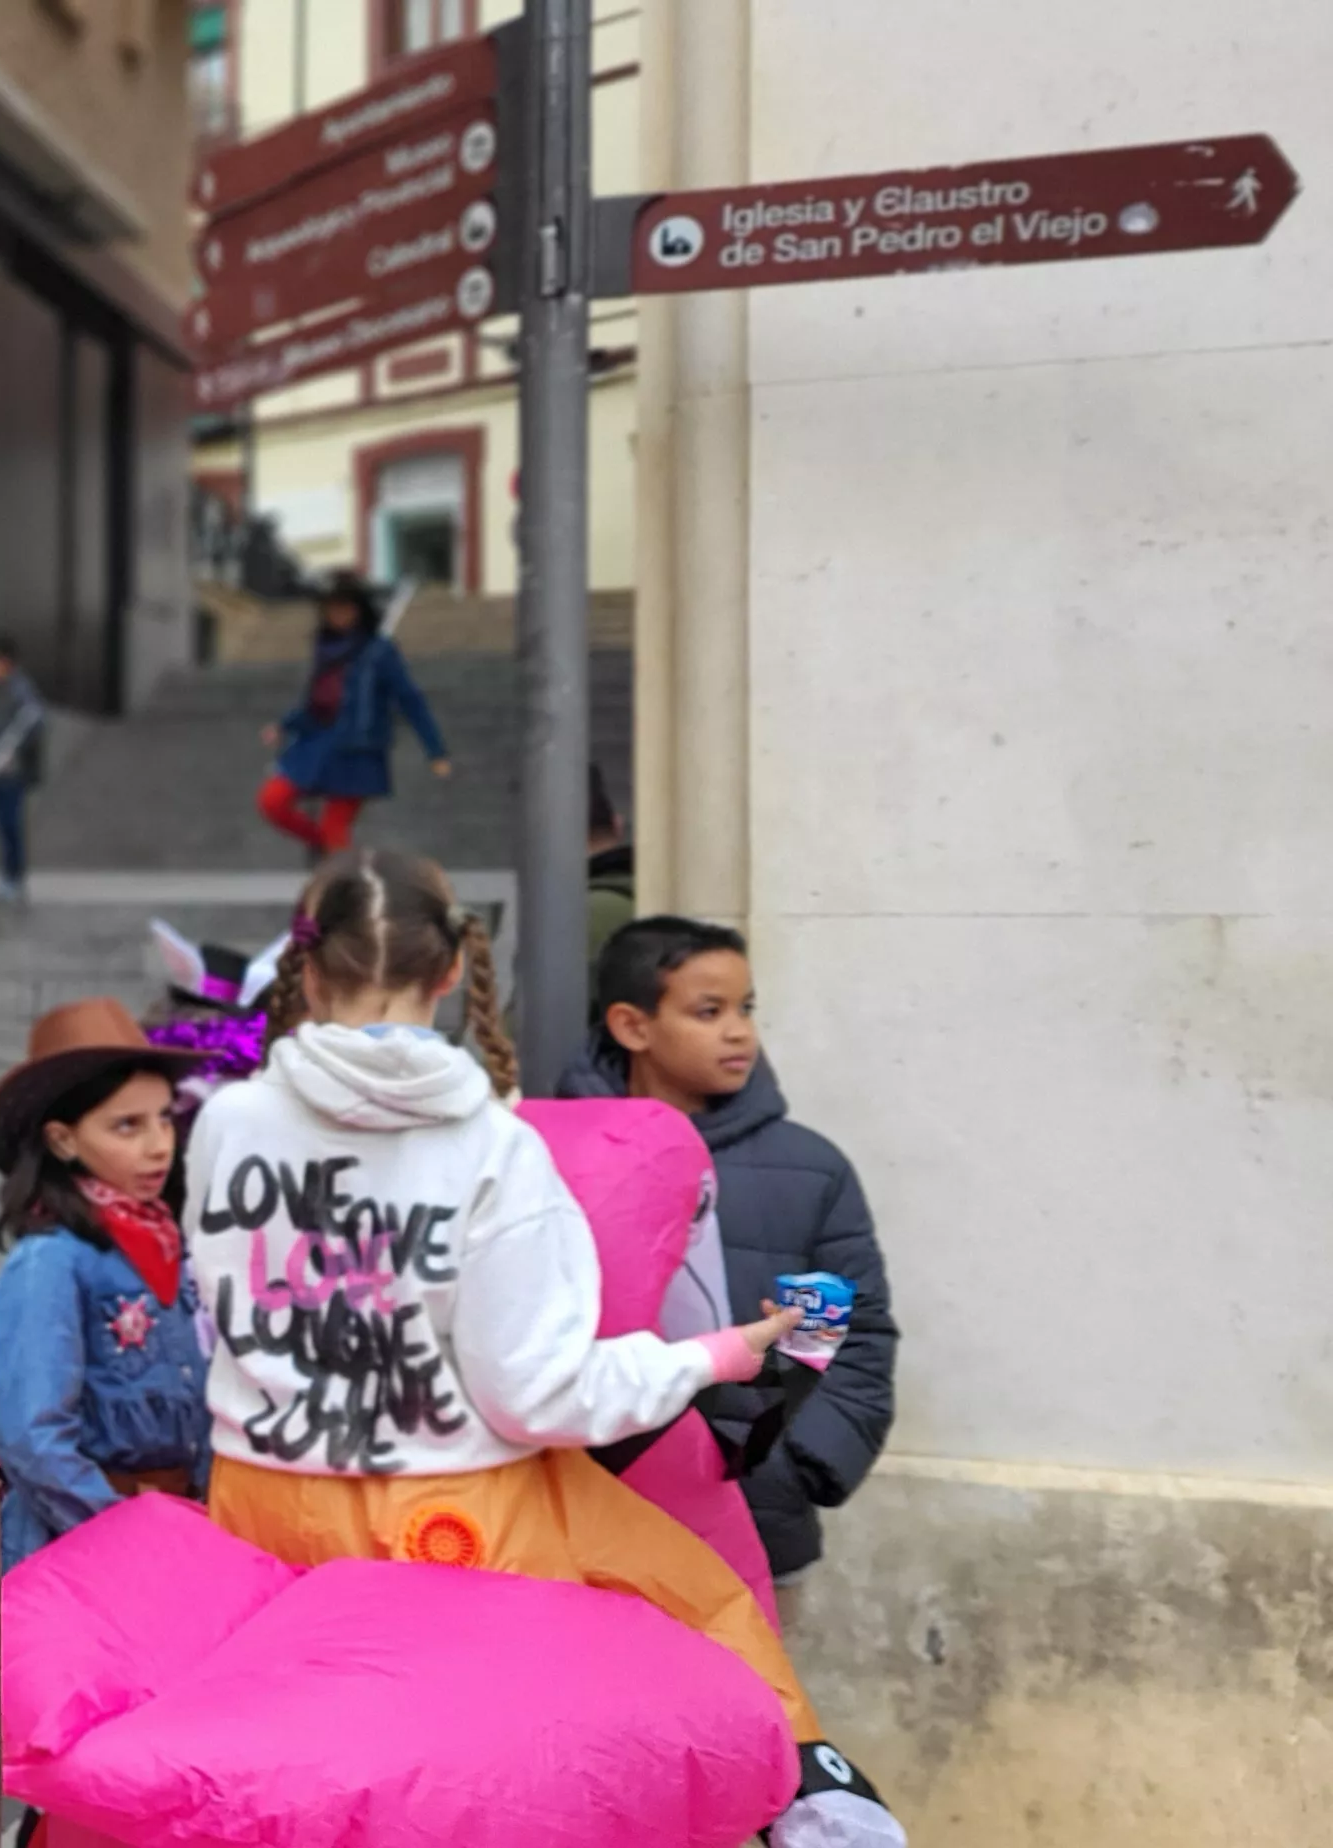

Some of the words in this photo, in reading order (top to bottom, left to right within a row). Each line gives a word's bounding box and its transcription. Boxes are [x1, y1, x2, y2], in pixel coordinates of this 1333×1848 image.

[718, 237, 765, 268] de
[773, 231, 842, 264] San
[851, 222, 963, 257] Pedro
[970, 214, 1004, 246] el
[1012, 205, 1108, 247] Viejo
[721, 195, 835, 239] Iglesia
[841, 197, 865, 227] y
[874, 178, 1031, 217] Claustro
[200, 1154, 359, 1235] LOVE
